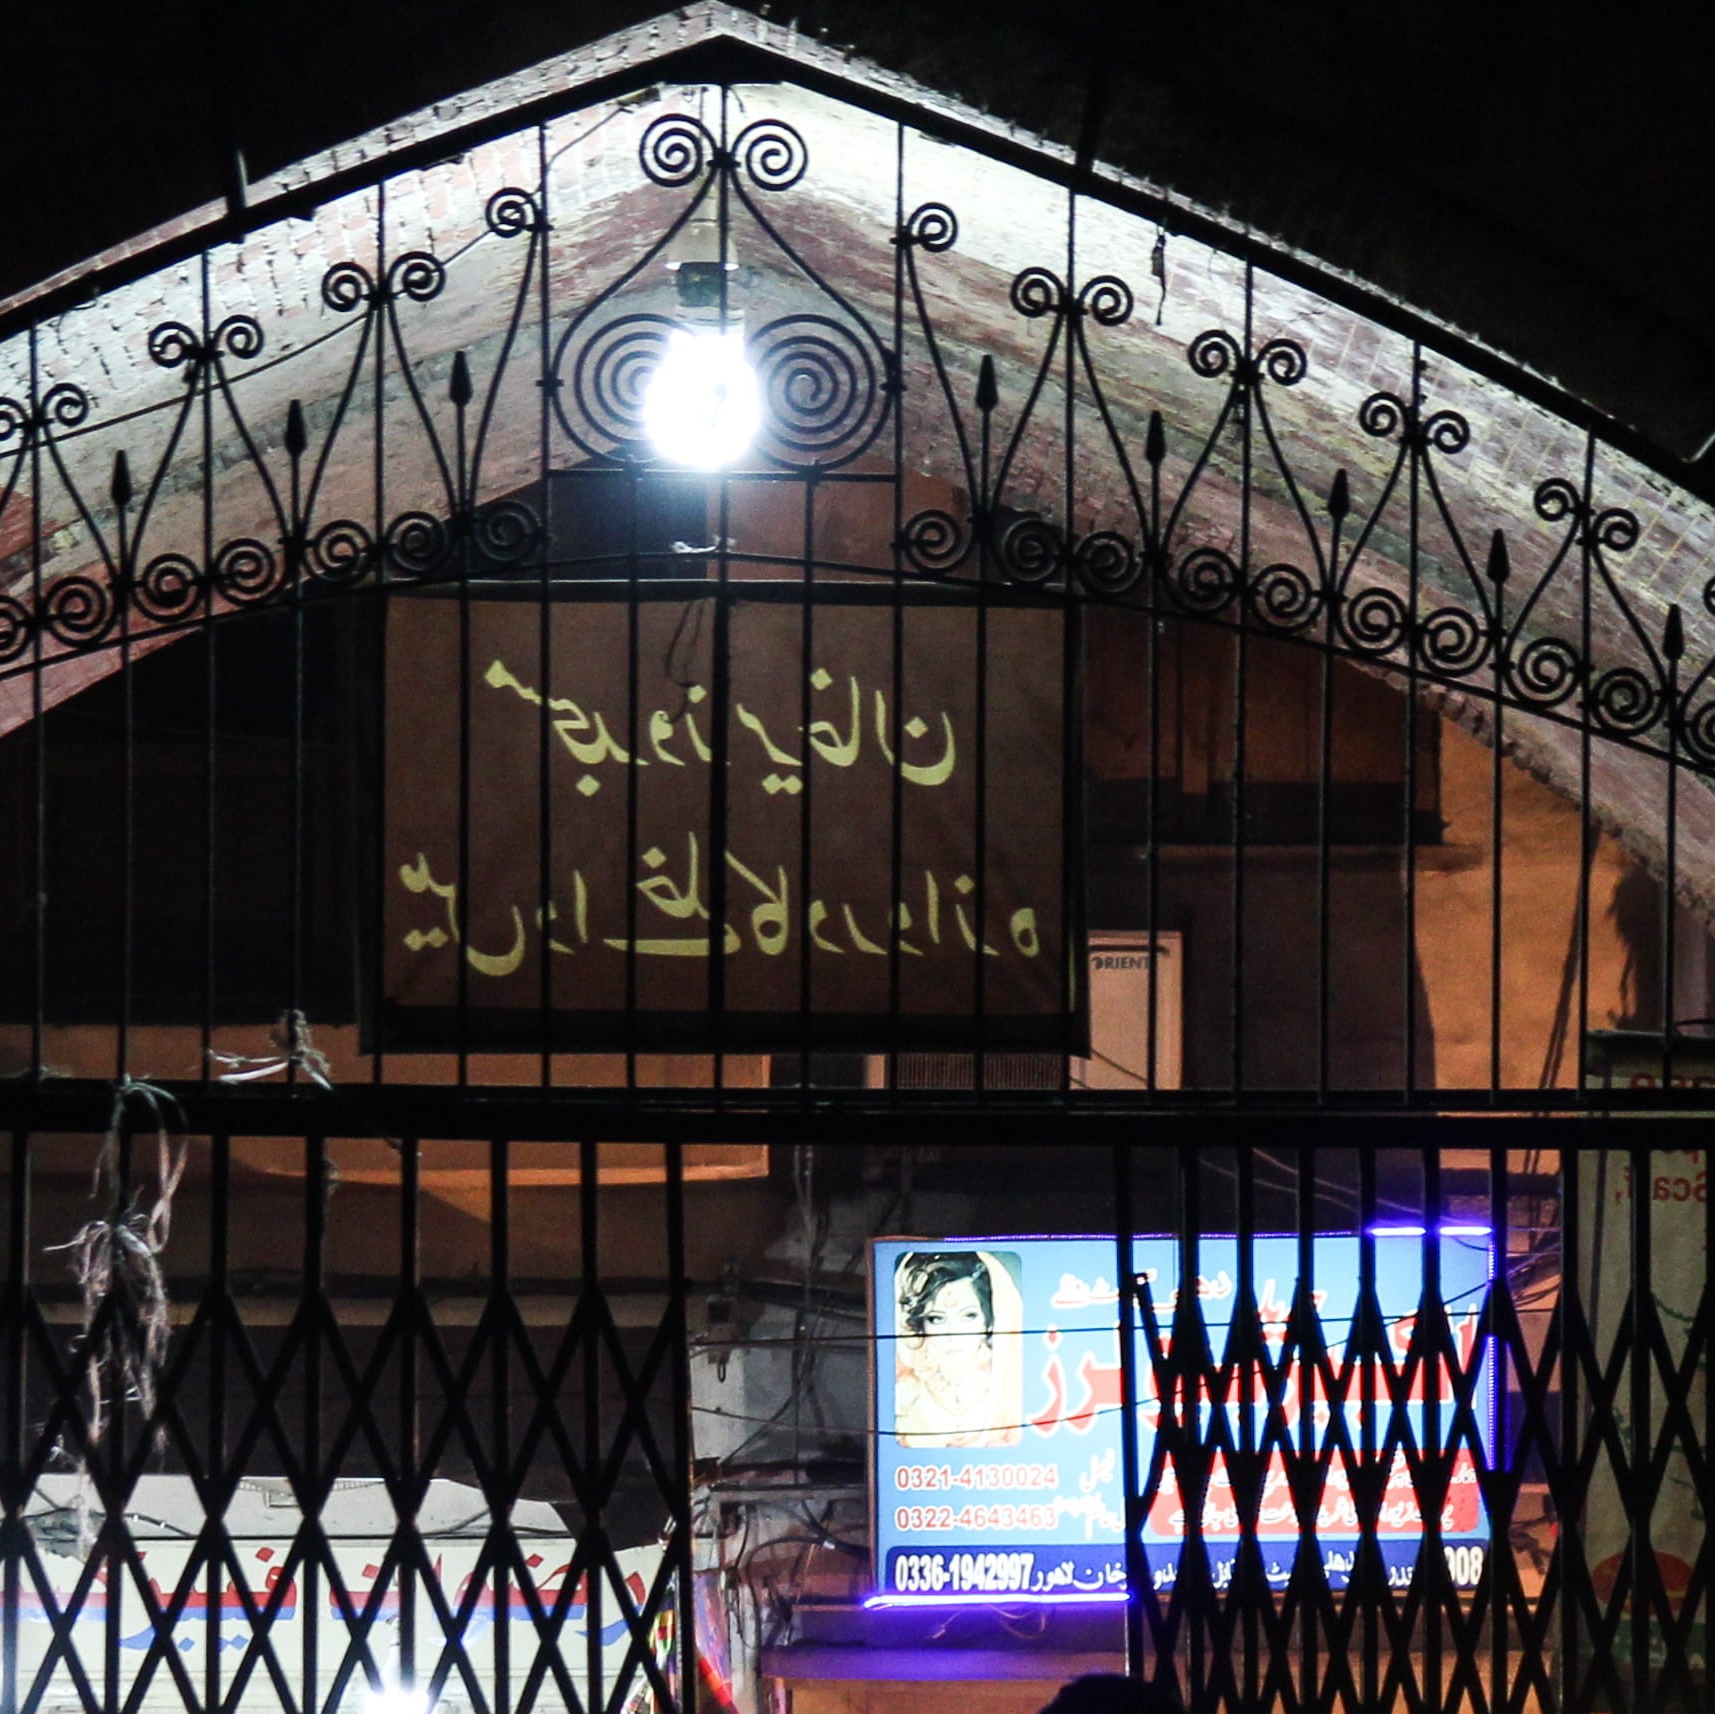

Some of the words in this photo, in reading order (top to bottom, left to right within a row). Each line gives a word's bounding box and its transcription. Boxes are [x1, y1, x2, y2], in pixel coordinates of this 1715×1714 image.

[1091, 956, 1150, 970] ORIENT
[895, 1465, 1058, 1490] 0321-4130024
[895, 1506, 1058, 1531] 0322-4643463
[894, 1552, 1034, 1592] 0336-1942997
